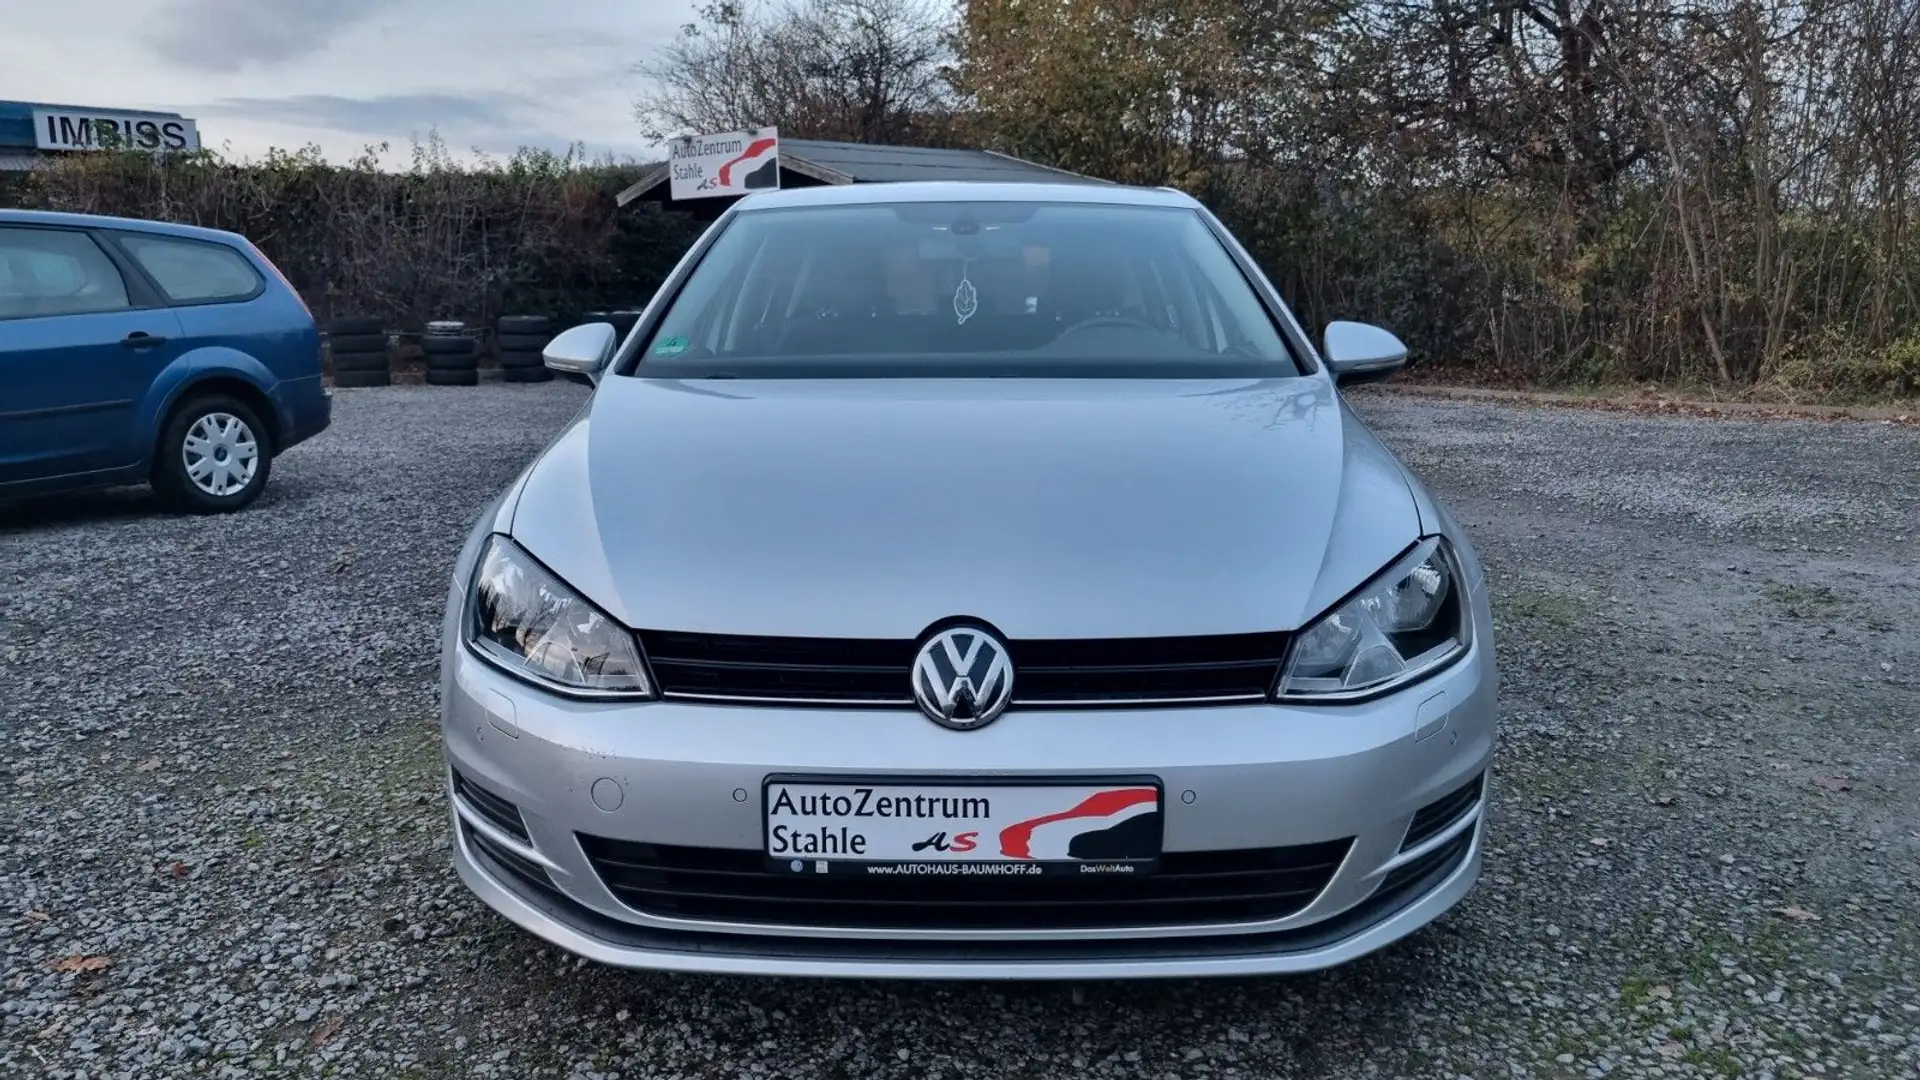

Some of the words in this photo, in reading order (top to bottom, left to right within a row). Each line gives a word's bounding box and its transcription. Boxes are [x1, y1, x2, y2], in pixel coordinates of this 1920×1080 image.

[47, 115, 187, 149] IMBISS
[672, 139, 743, 160] AutoZentrum
[673, 163, 703, 181] Stahle
[770, 787, 990, 818] AutoZentrum
[772, 825, 866, 854] Stahle
[867, 864, 1042, 875] www.AUTOHAUS-BAUMHOFF.de
